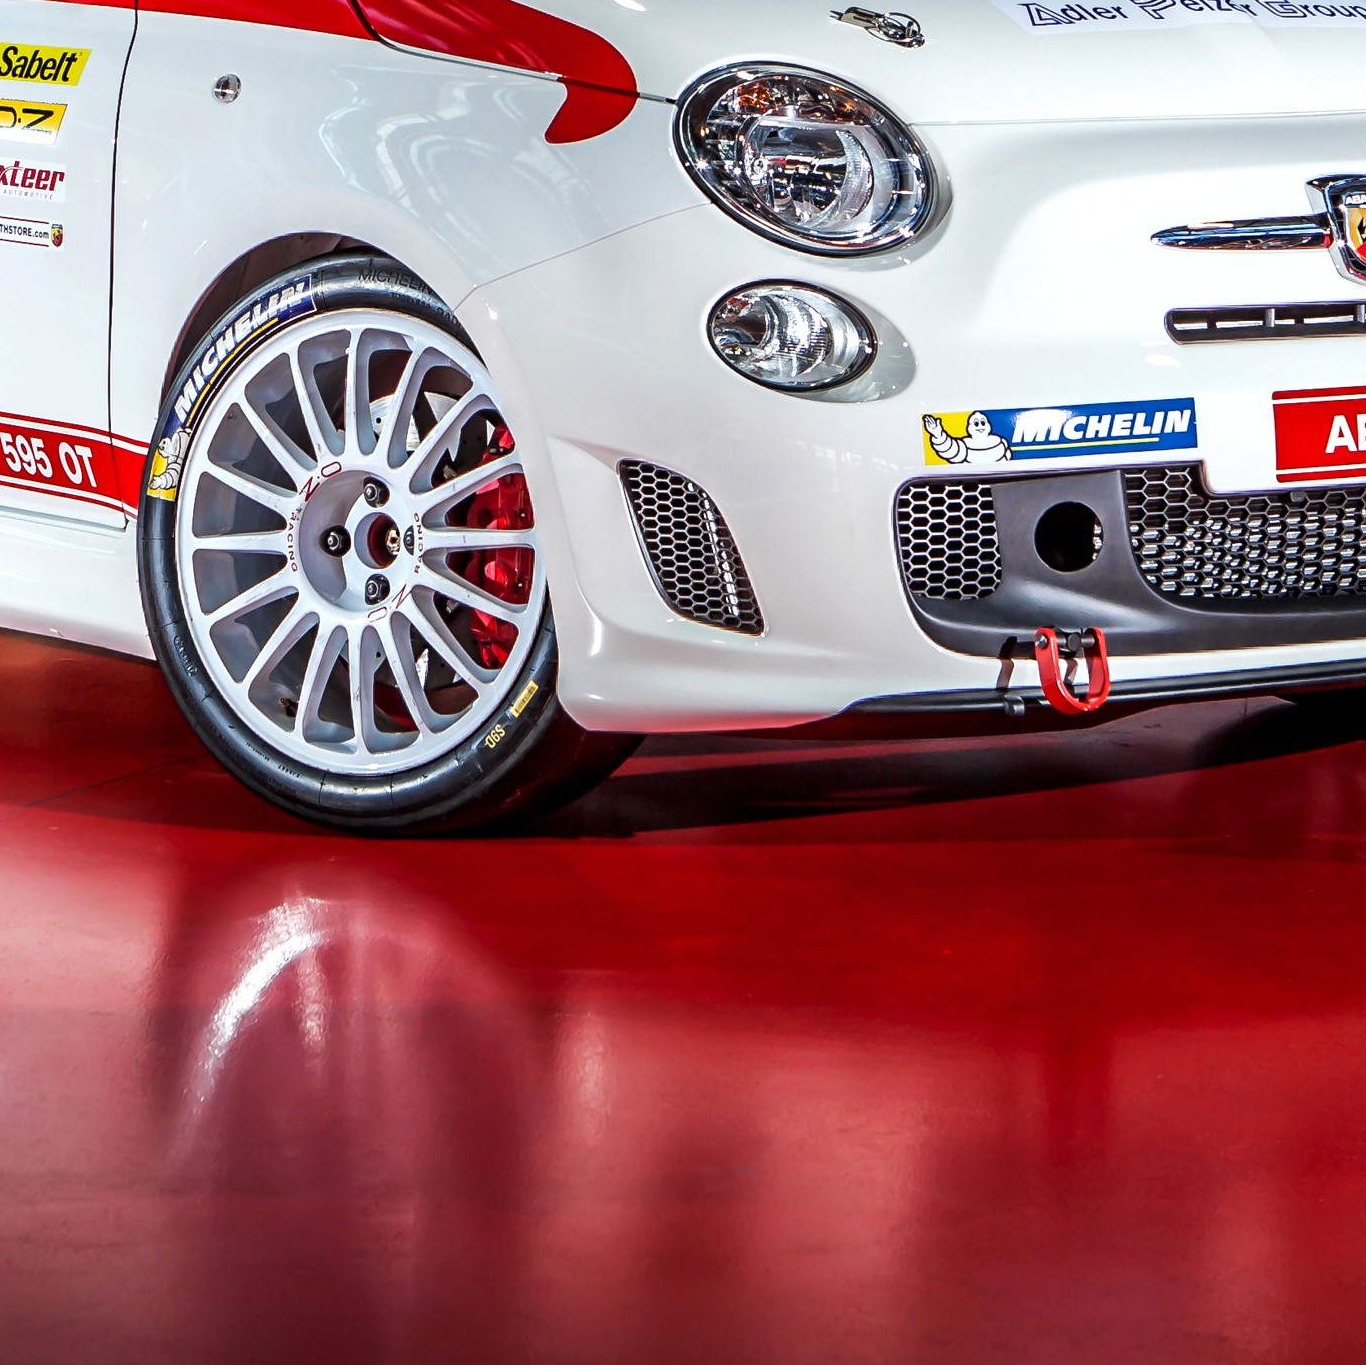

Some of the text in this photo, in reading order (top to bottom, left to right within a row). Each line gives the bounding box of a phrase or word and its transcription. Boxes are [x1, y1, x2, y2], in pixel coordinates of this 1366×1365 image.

[1017, 3, 1129, 26] Adler
[3, 188, 53, 200] AUTOMOTIVE
[173, 280, 307, 423] MICHELIN
[1012, 409, 1192, 443] MICHELIN
[0, 431, 53, 479] 595
[58, 441, 97, 488] OT
[287, 512, 298, 573] RACING
[414, 512, 423, 574] RACING
